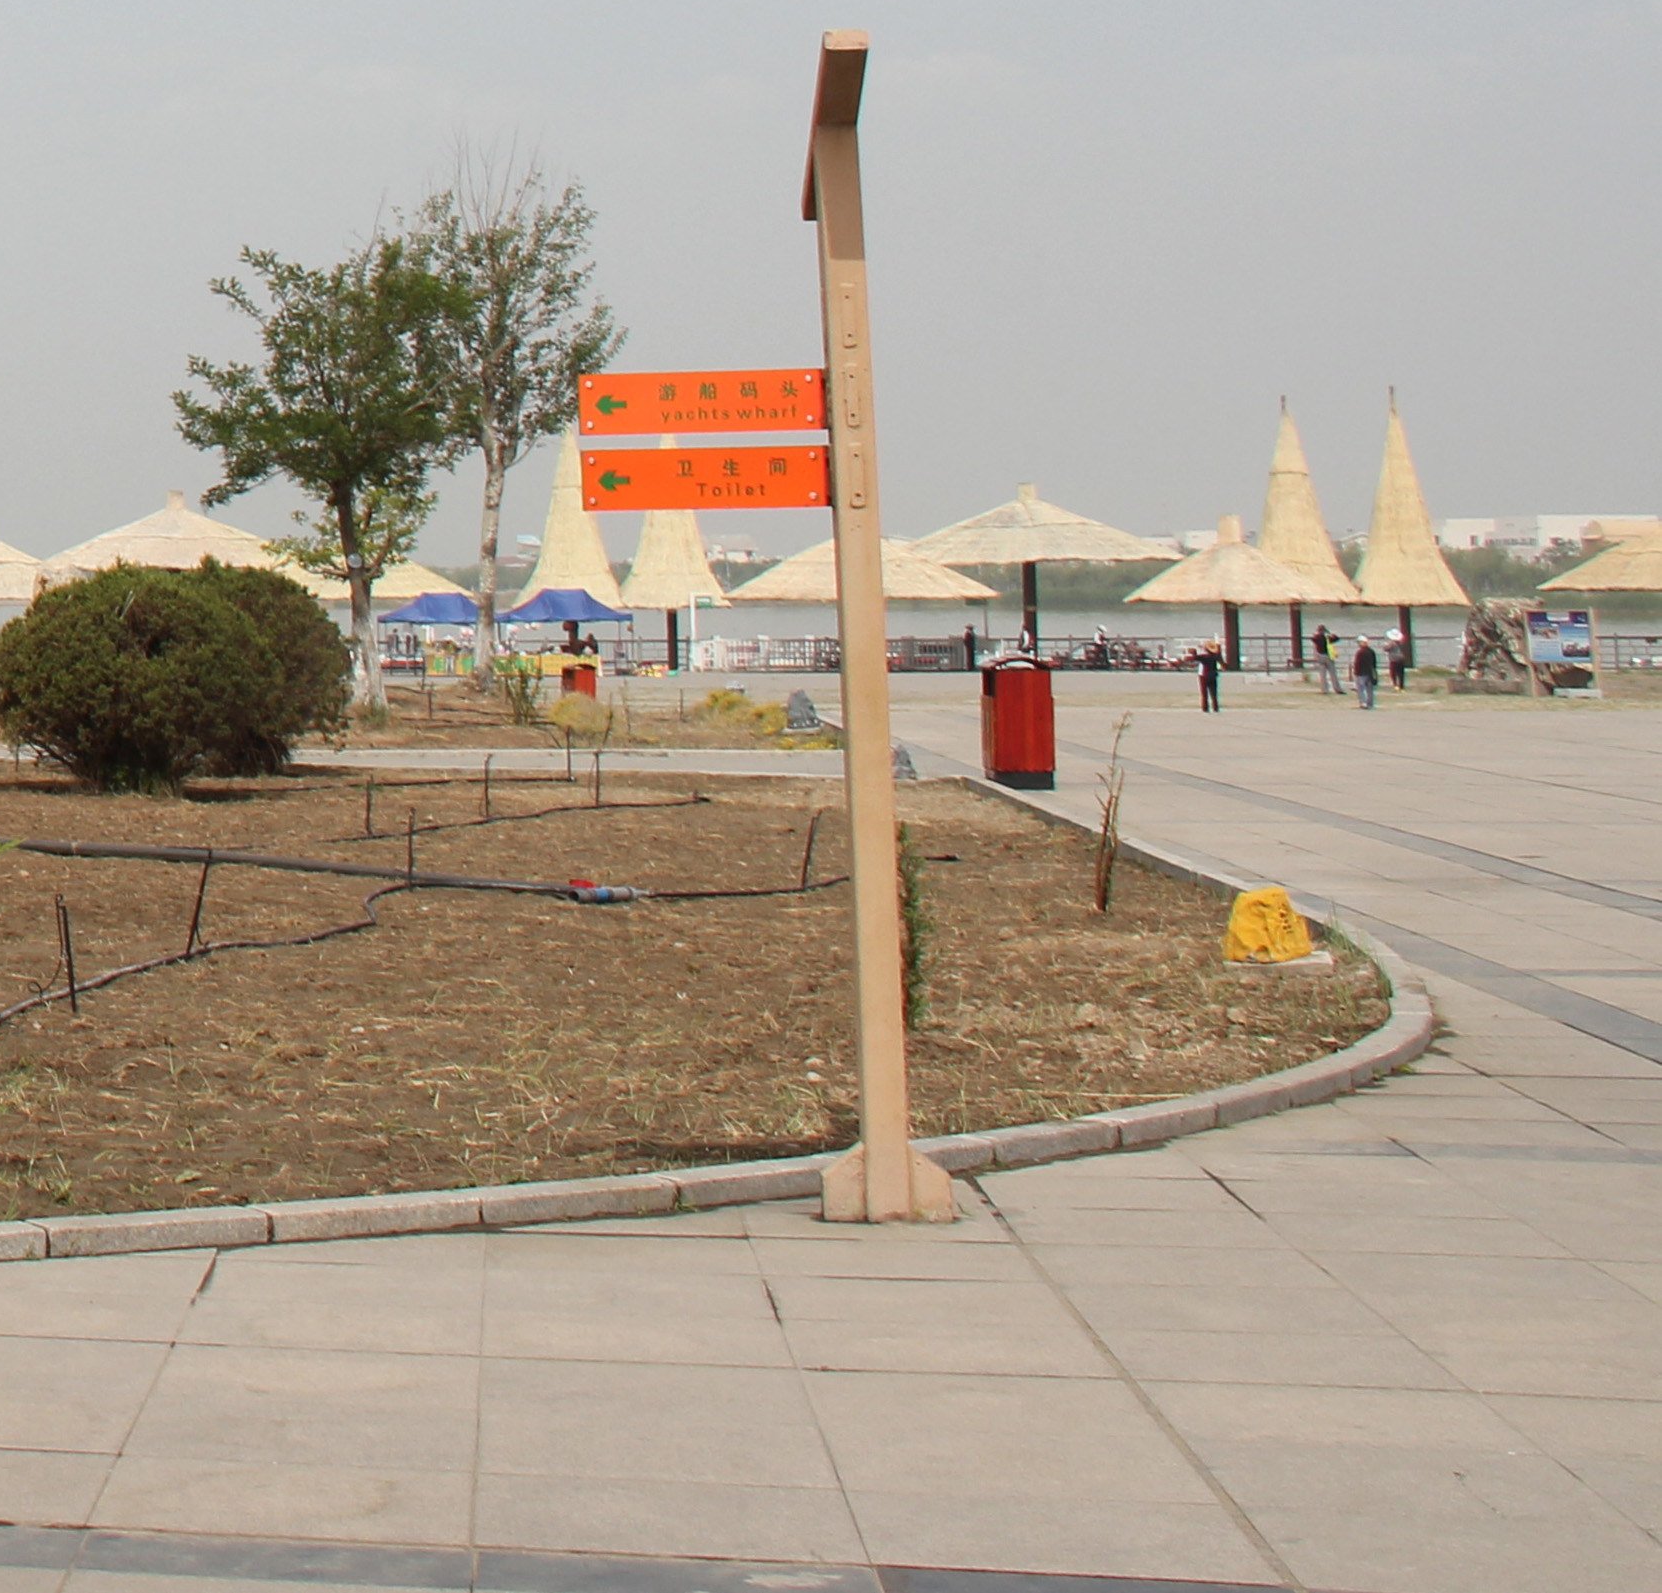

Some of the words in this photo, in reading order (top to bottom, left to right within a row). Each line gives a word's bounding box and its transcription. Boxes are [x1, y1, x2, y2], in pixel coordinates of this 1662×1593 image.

[658, 380, 798, 401] 游船码头
[660, 407, 730, 423] yachts
[736, 404, 798, 420] wharf
[676, 456, 788, 478] 卫生间
[695, 482, 767, 498] Toilet
